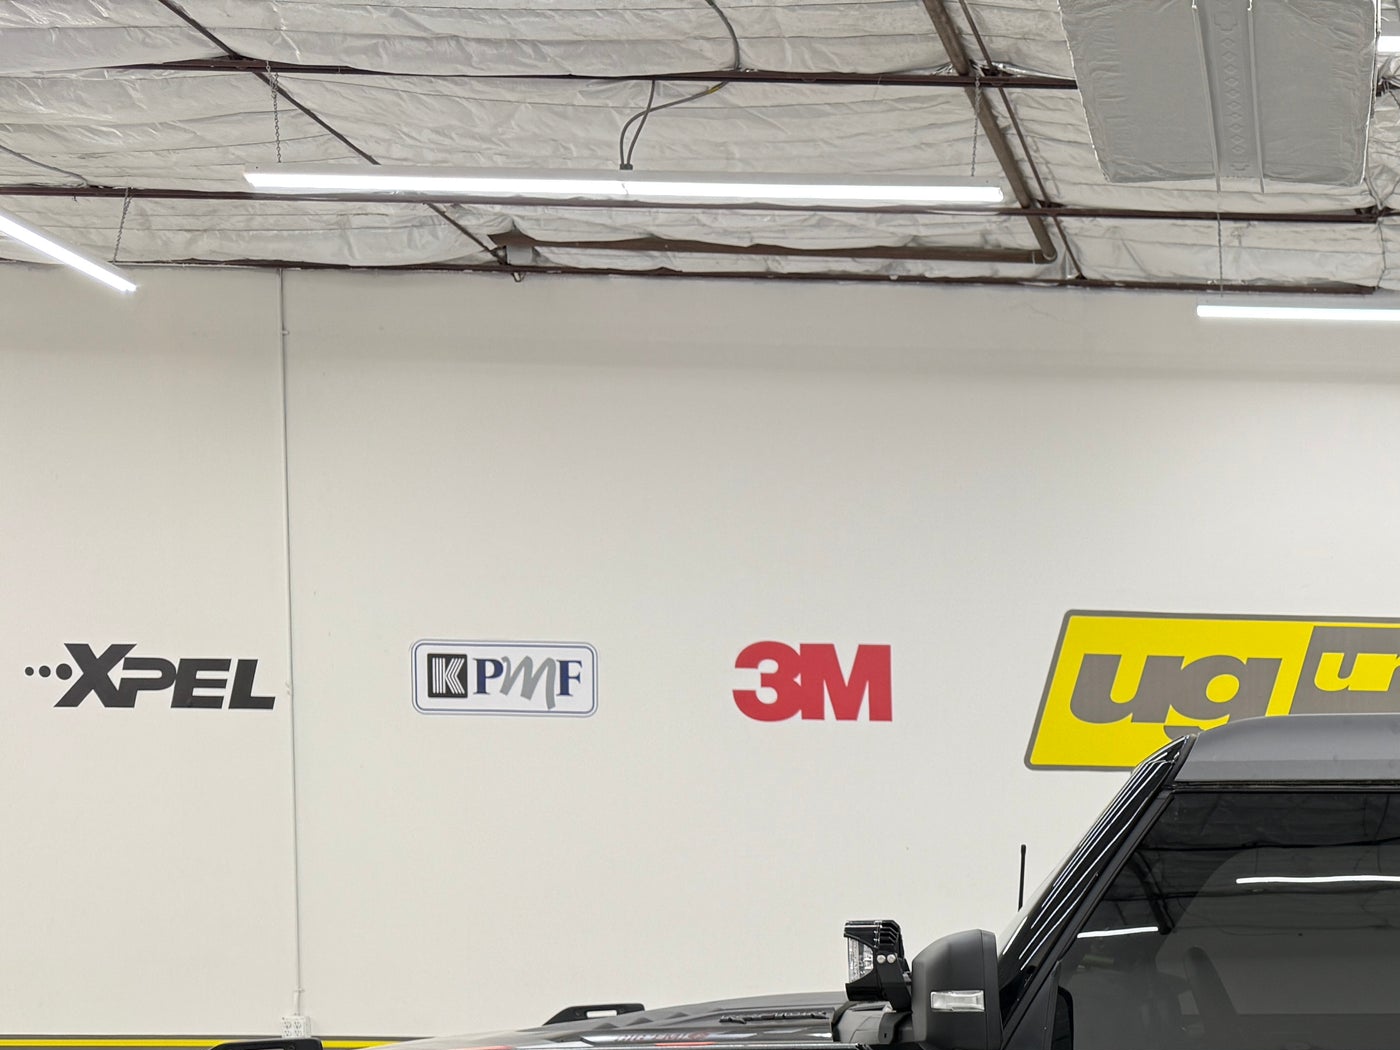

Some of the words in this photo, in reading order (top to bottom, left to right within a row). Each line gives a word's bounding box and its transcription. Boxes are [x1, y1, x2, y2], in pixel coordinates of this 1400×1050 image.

[53, 643, 276, 710] XPEL
[732, 640, 893, 722] 3M
[1070, 653, 1283, 741] ug
